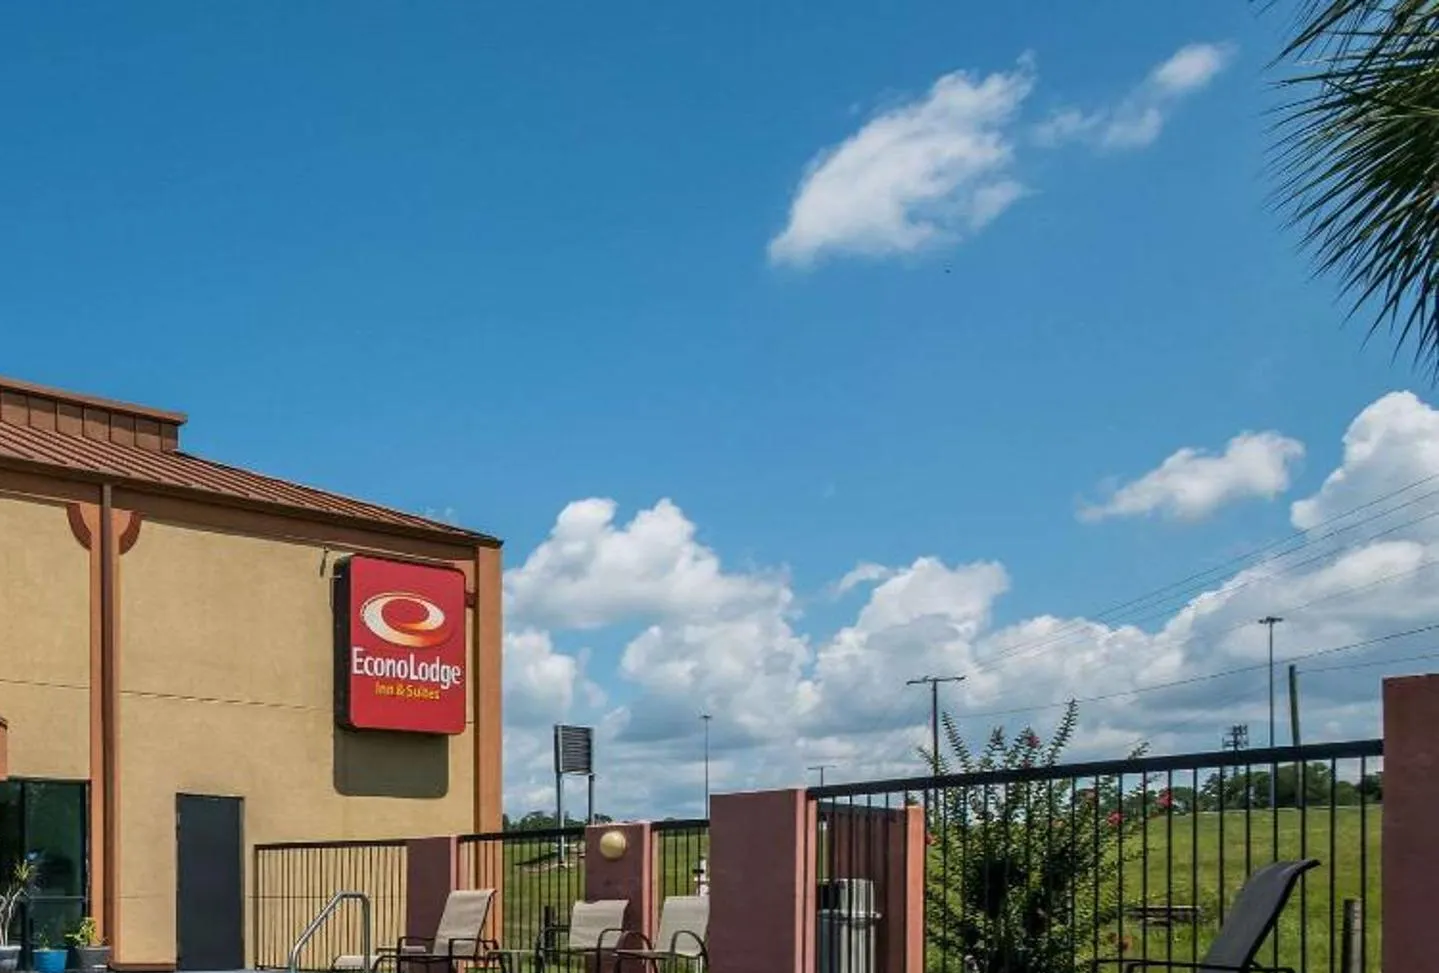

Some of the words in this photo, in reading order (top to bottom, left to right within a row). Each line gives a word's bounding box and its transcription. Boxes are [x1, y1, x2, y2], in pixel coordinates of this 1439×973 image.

[352, 646, 461, 690] EconoLodge
[375, 681, 394, 696] Inn
[406, 684, 440, 700] Suites
